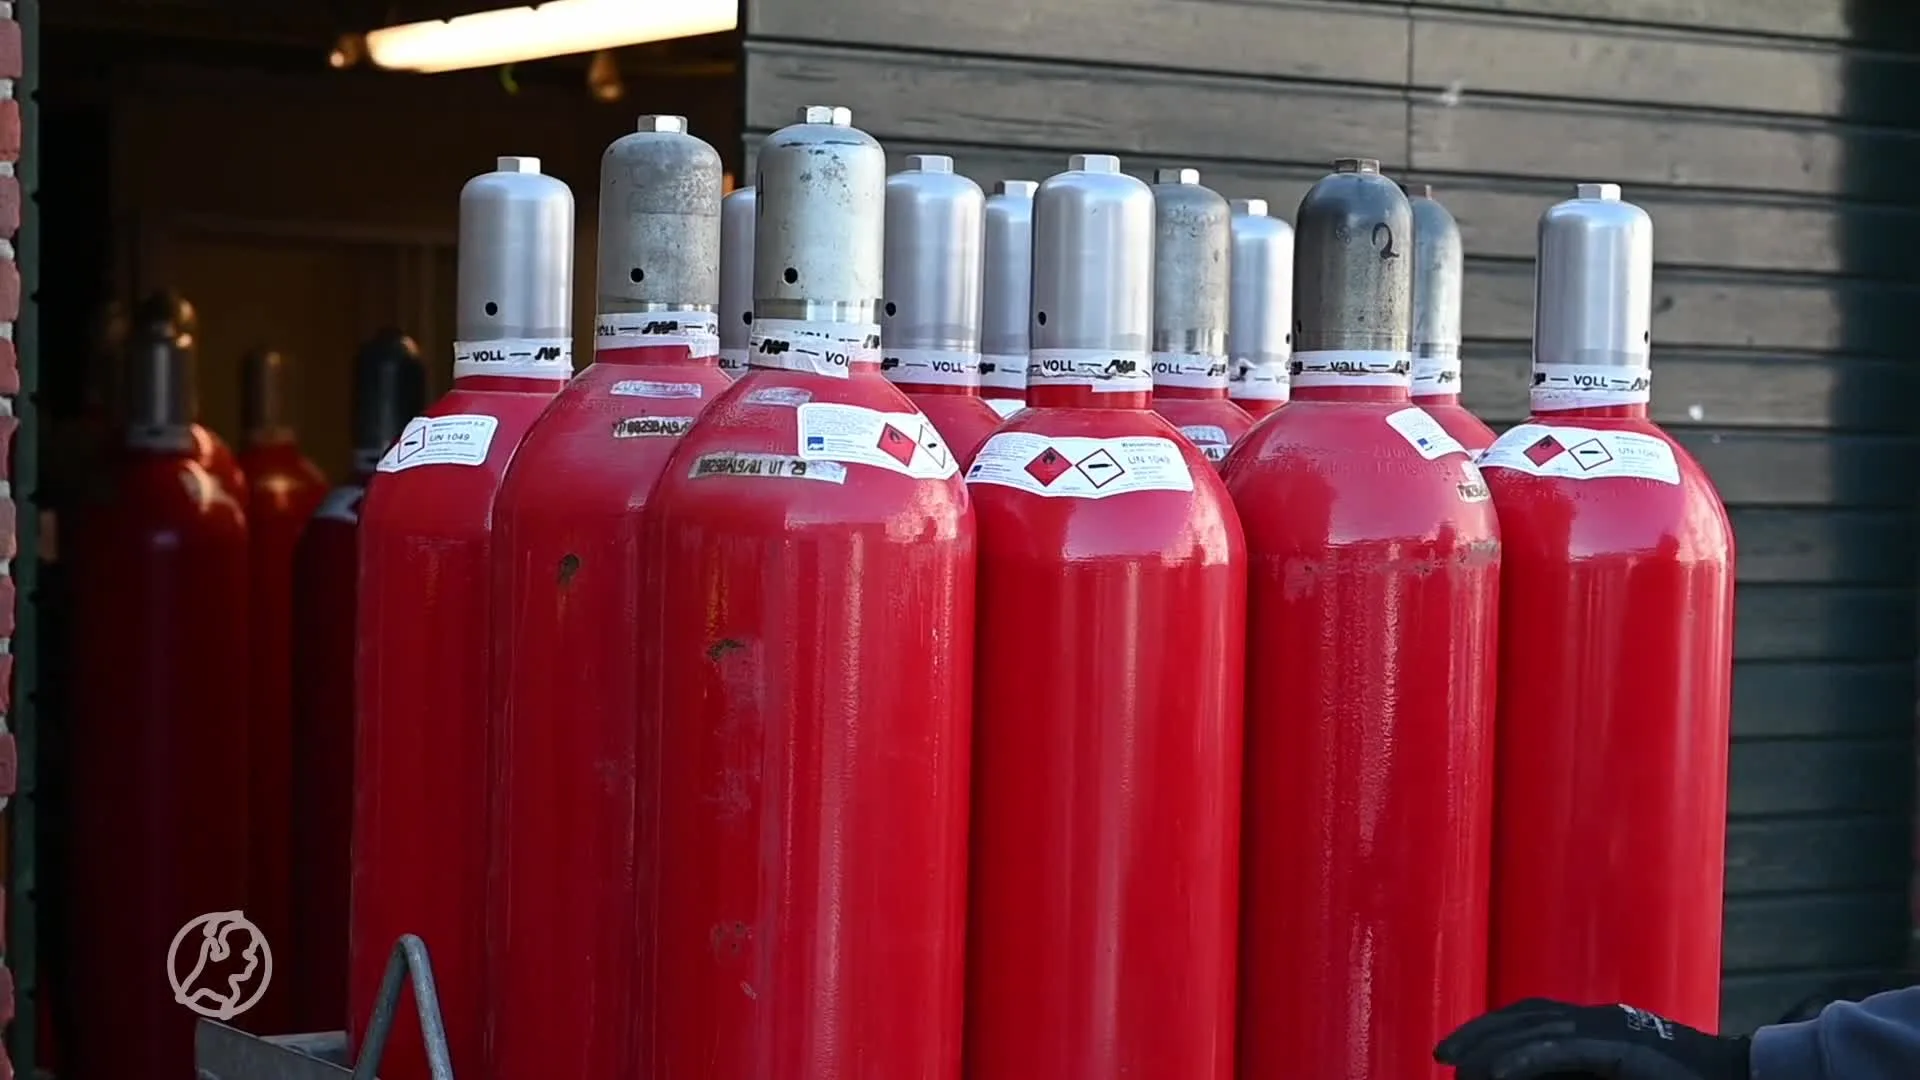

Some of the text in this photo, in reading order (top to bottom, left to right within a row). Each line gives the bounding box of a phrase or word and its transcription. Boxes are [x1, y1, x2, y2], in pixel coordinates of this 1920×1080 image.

[1371, 221, 1400, 260] 2
[472, 350, 505, 362] VOLL
[719, 358, 738, 369] OLL
[932, 360, 964, 374] VOLL
[1043, 359, 1076, 372] VOLL
[1152, 362, 1183, 375] VOLL
[1330, 361, 1364, 372] VOLL
[1574, 375, 1608, 388] VOLL
[448, 433, 470, 441] 1049
